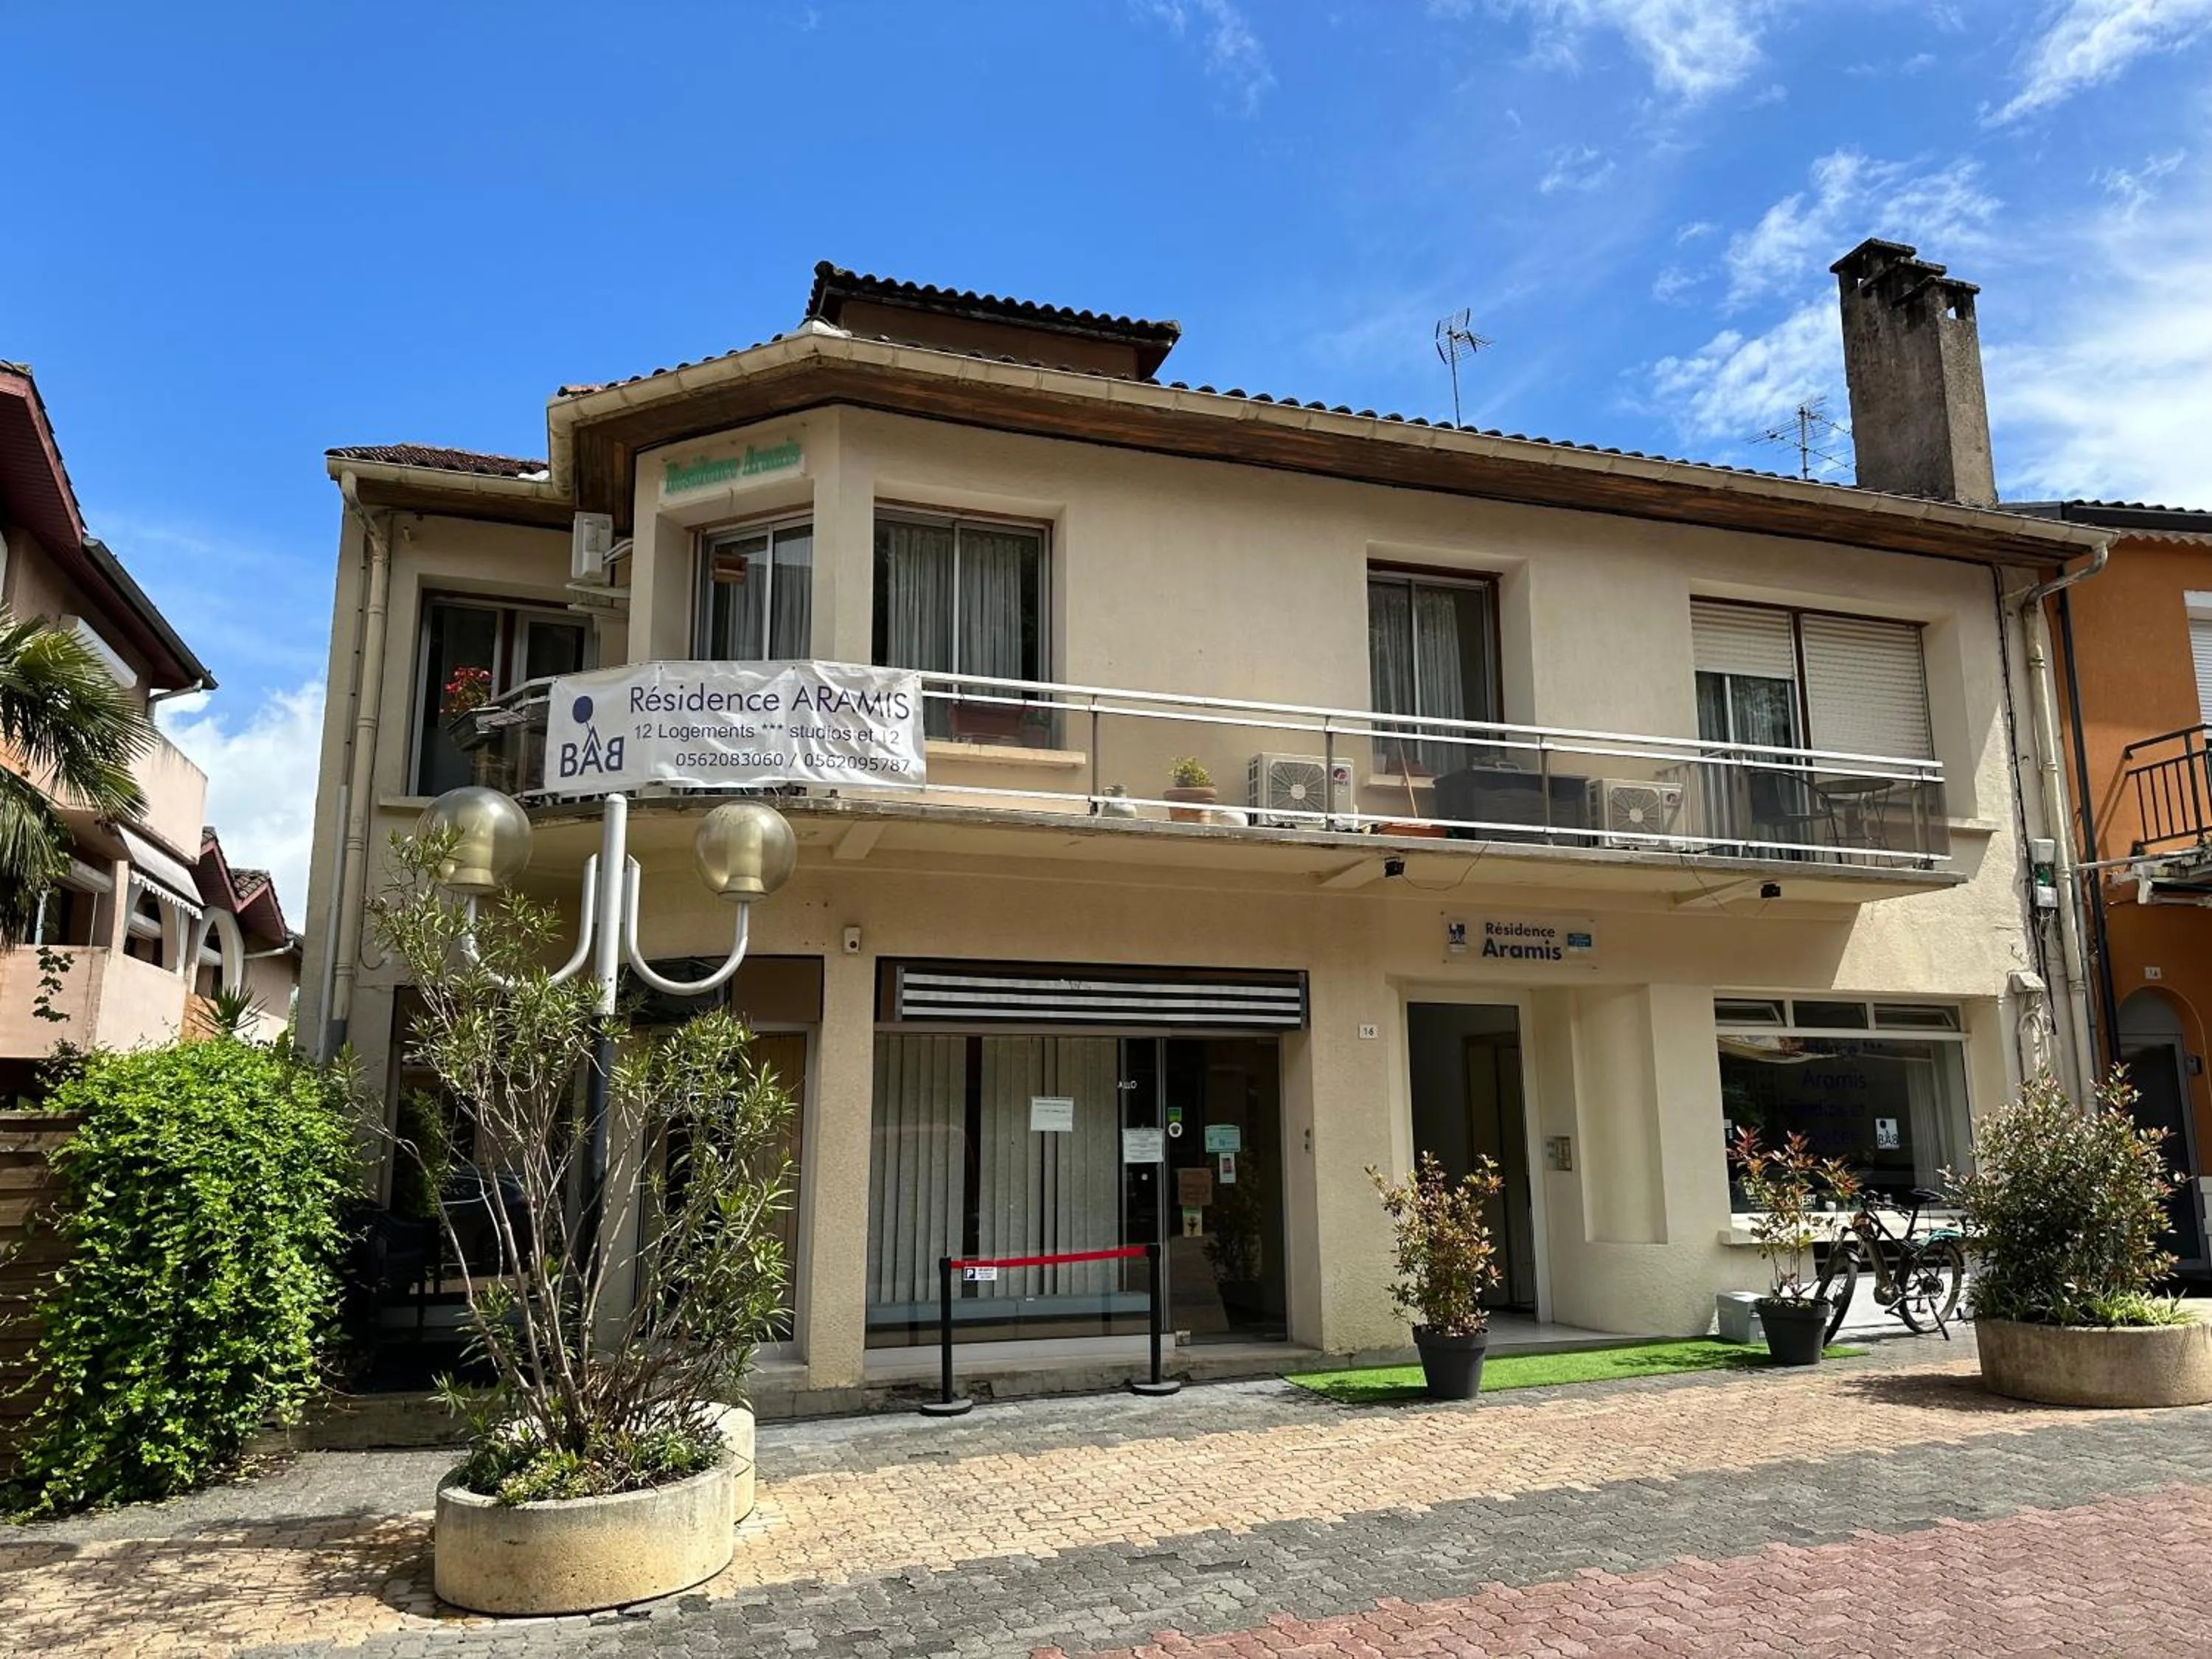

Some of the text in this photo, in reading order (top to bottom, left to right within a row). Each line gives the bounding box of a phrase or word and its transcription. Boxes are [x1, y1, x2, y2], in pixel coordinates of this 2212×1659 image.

[630, 682, 910, 720] Résidence ARAMIS
[634, 723, 653, 740] 12
[658, 723, 755, 742] Logements
[790, 725, 852, 741] studios
[858, 728, 874, 742] et
[676, 753, 784, 767] 0562083060
[804, 753, 911, 772] 0562095787
[1485, 922, 1556, 938] Résidence
[1482, 937, 1562, 961] Aramis
[1802, 1069, 1867, 1090] Aramis
